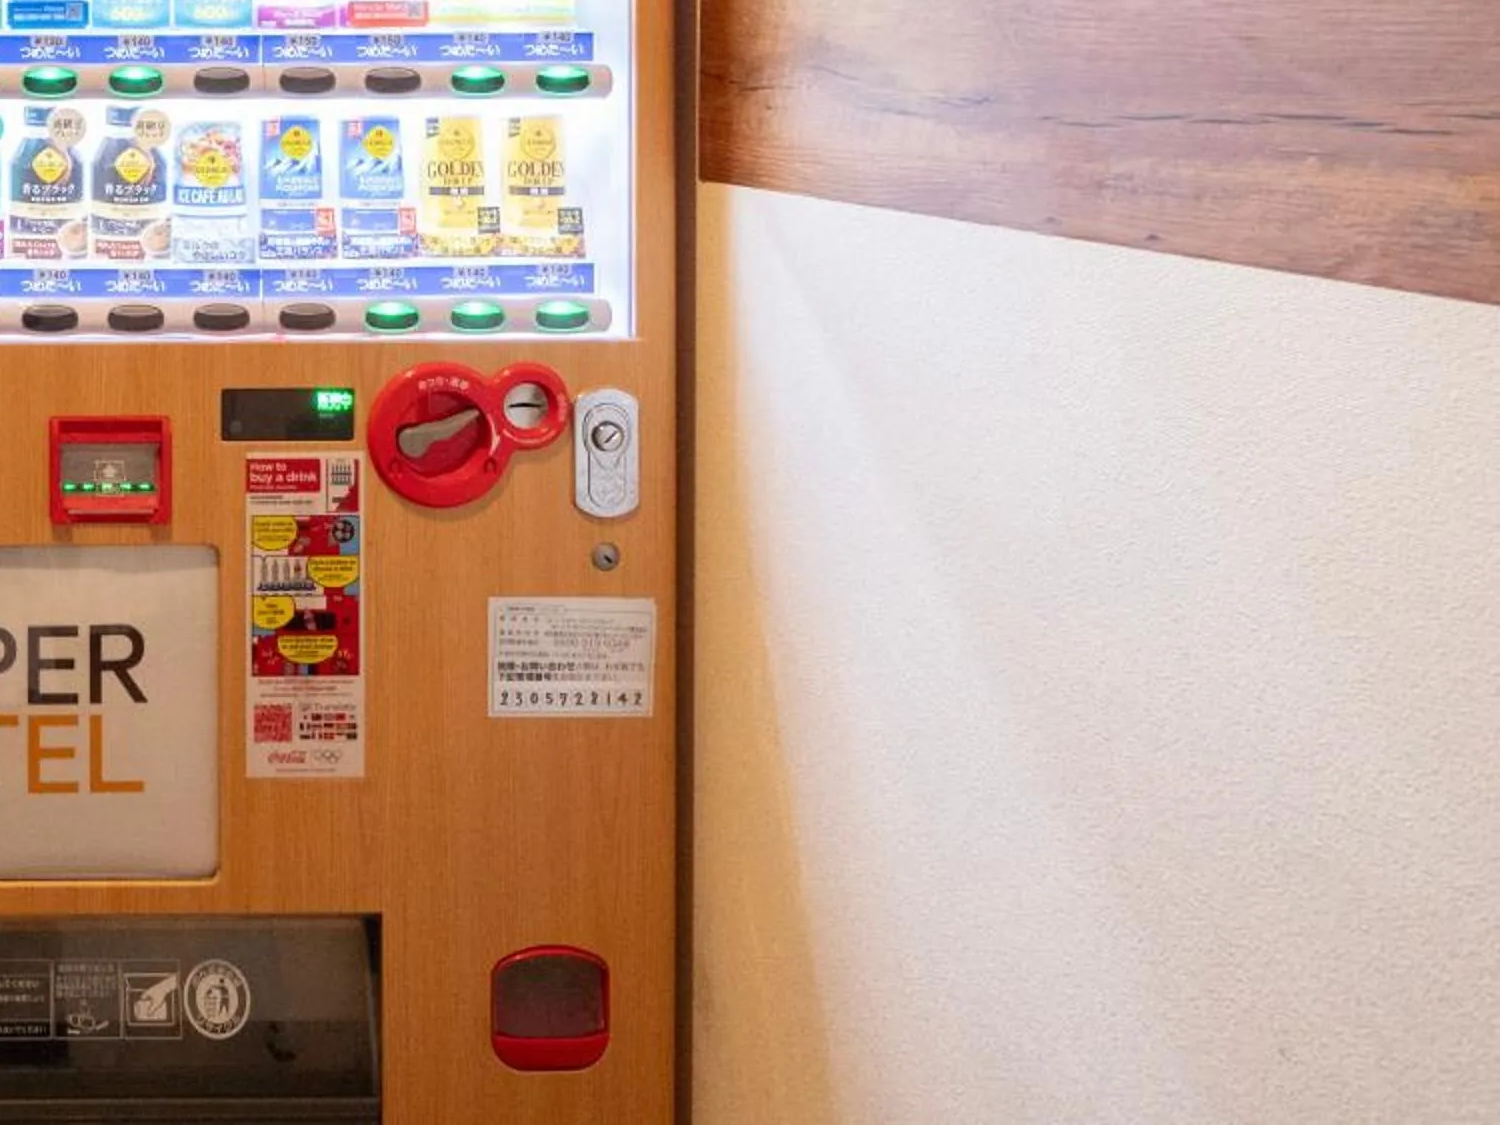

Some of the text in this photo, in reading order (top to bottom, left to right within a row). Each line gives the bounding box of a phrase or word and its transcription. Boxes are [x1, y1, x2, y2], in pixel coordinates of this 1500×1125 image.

[250, 462, 287, 472] How to
[250, 471, 317, 484] buy a drink
